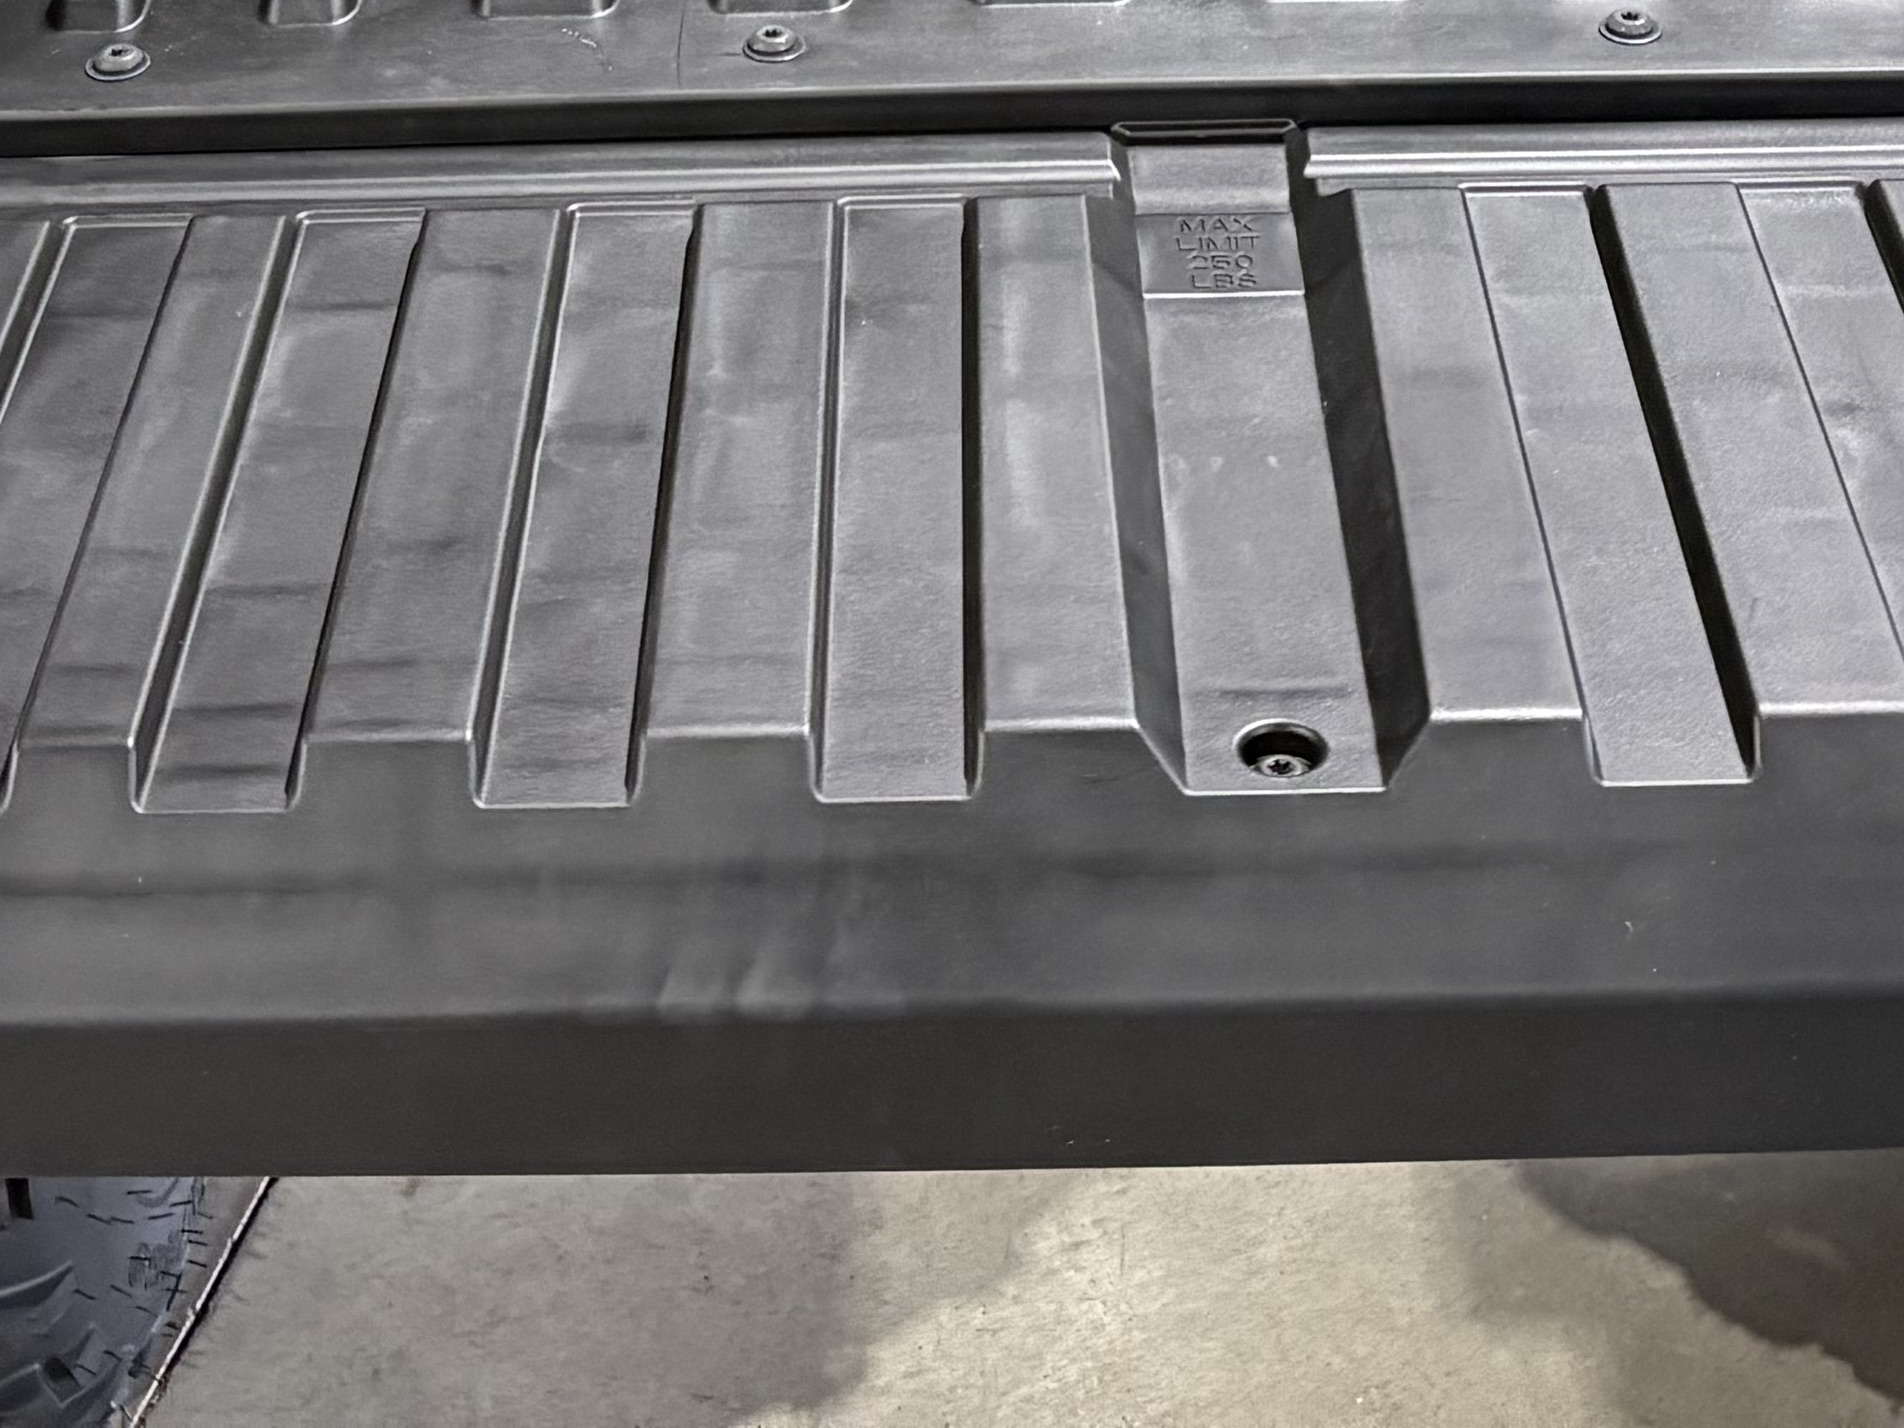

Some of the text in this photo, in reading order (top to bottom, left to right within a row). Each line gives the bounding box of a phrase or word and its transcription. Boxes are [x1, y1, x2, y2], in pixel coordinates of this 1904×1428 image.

[1178, 216, 1255, 233] MAX
[1173, 234, 1260, 252] LIMIT
[1187, 252, 1254, 270] 250
[1191, 270, 1257, 289] LBS
